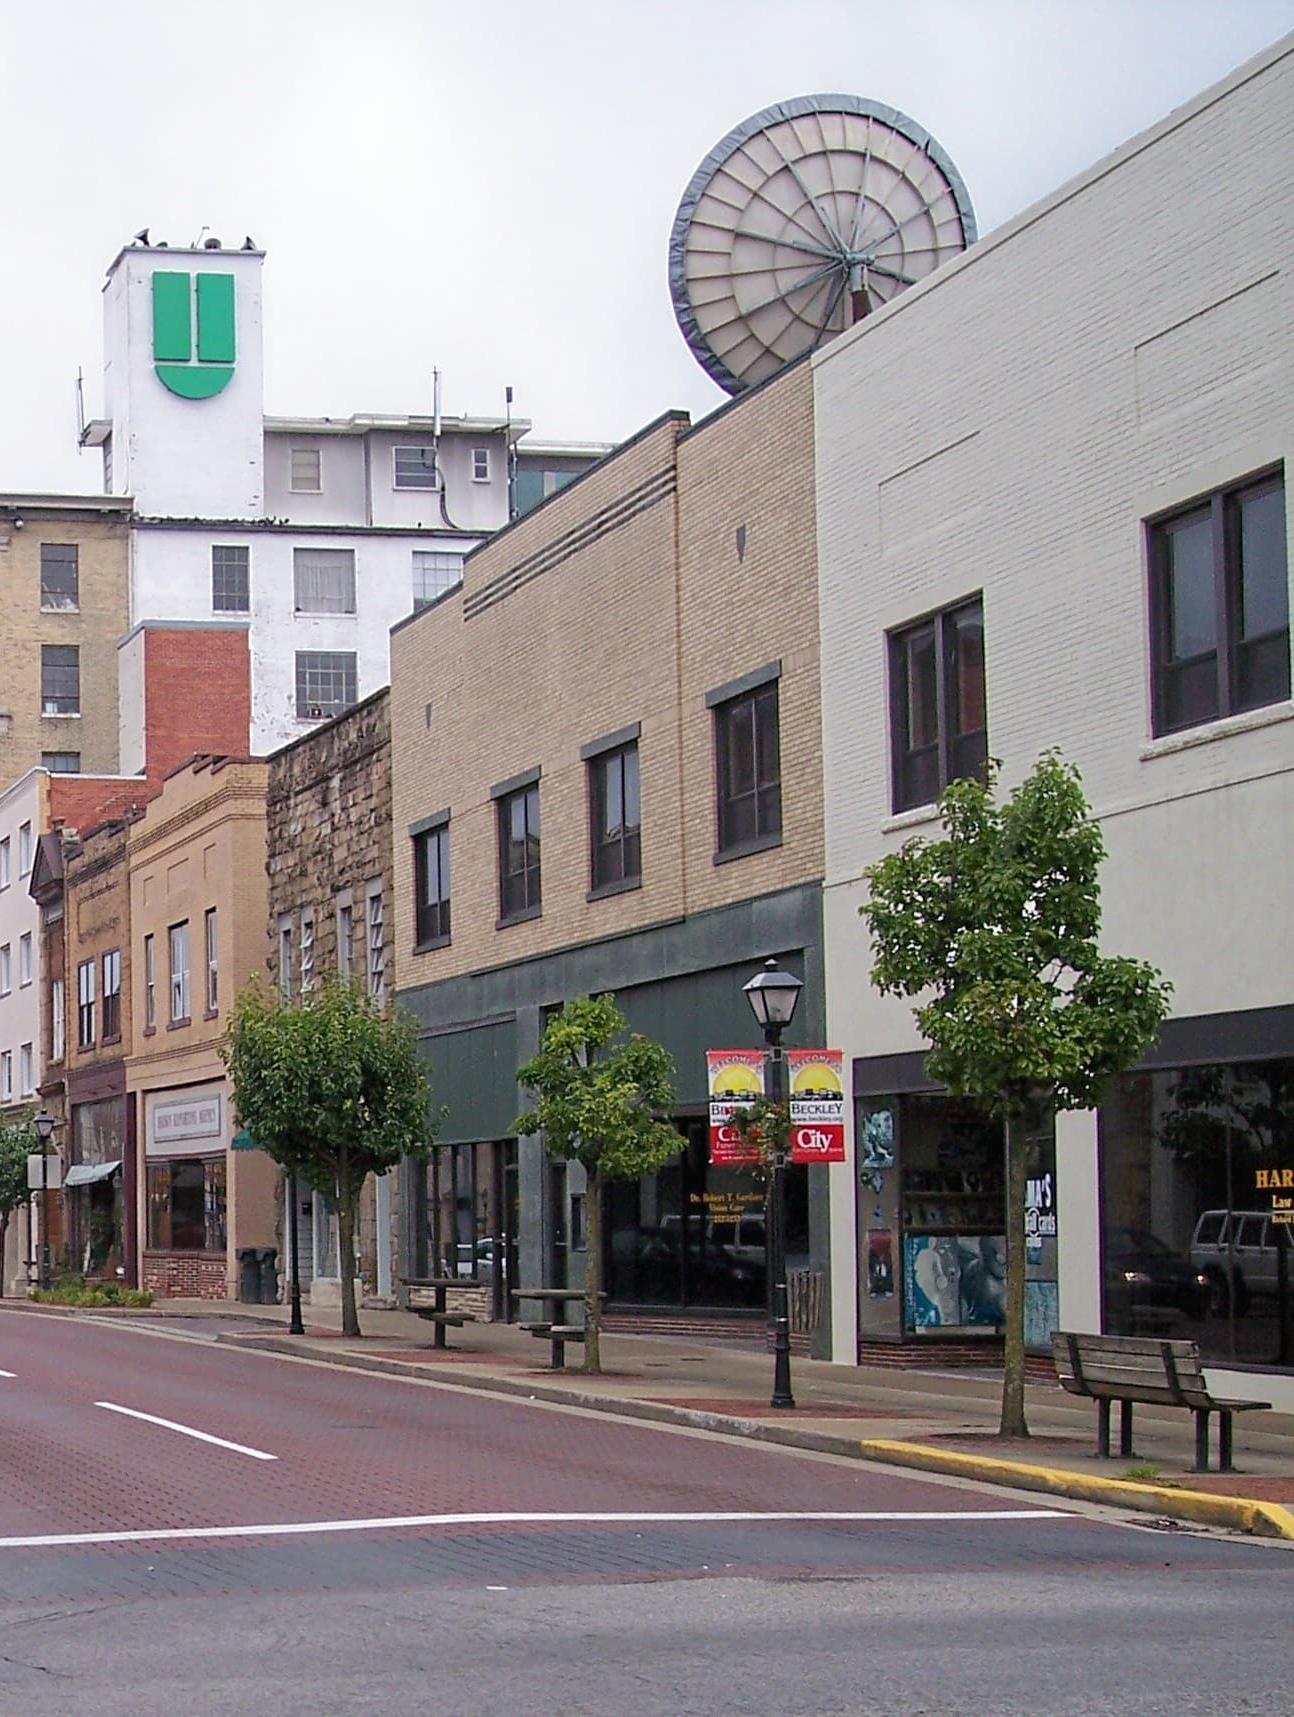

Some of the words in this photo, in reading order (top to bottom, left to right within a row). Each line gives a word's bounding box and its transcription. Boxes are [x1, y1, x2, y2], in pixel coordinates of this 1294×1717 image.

[792, 1103, 843, 1114] BECKLEY
[797, 1129, 833, 1152] City
[1272, 1195, 1293, 1208] Law
